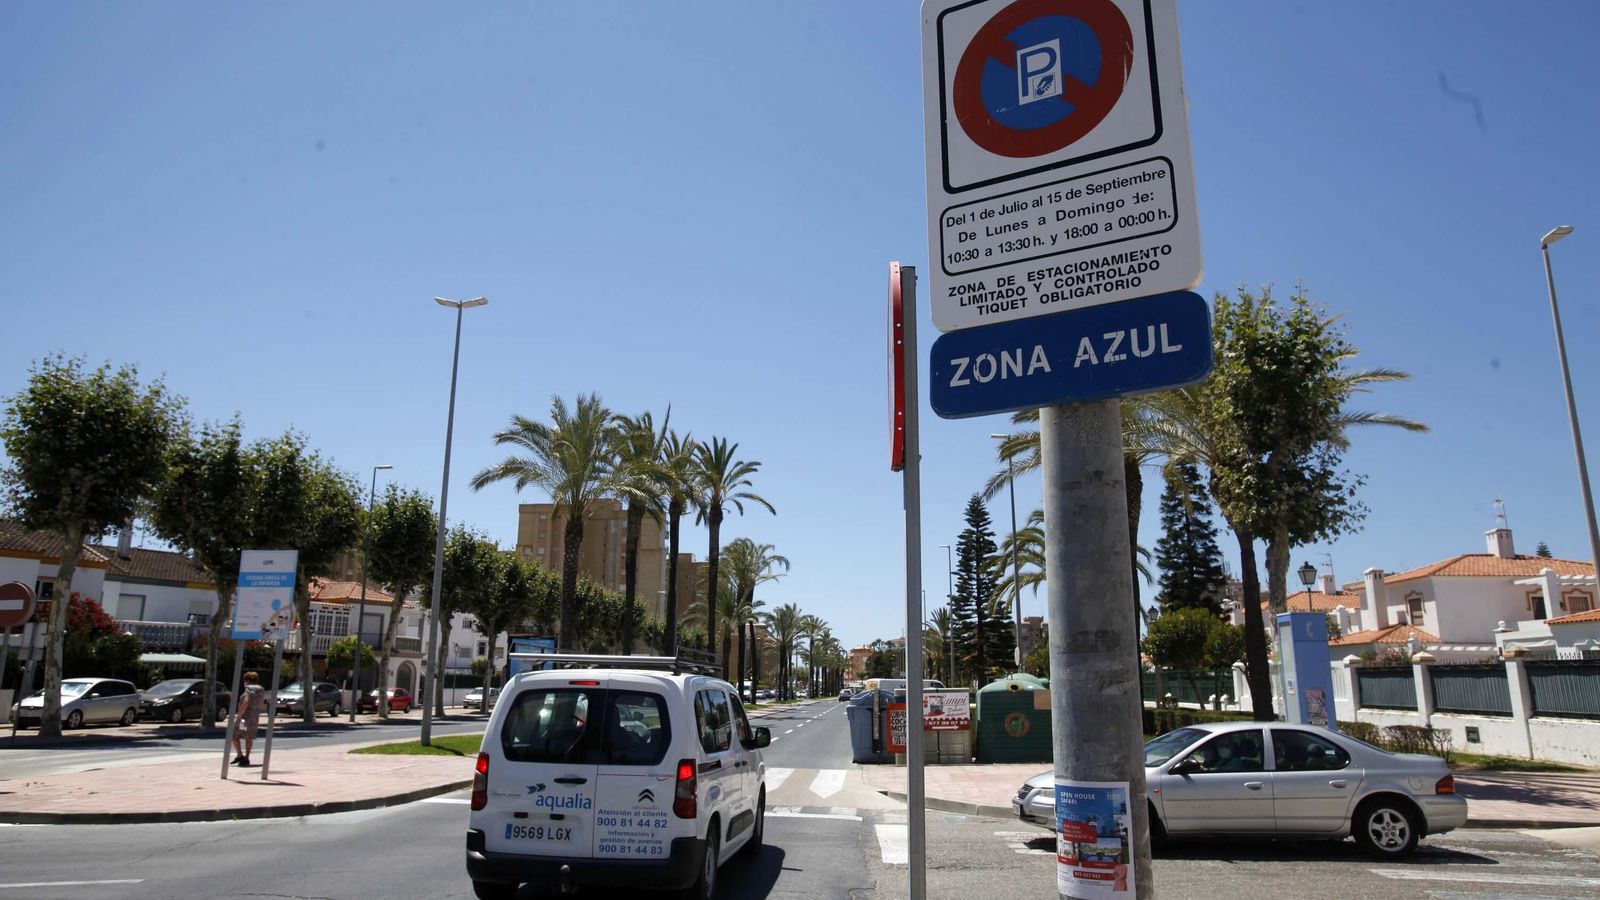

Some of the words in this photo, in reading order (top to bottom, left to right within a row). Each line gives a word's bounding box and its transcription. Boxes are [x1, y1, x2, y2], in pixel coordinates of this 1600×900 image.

[1020, 46, 1057, 97] P
[946, 213, 966, 228] Del
[969, 211, 975, 222] 1
[979, 208, 995, 220] de
[998, 201, 1028, 216] Julio
[1032, 195, 1043, 208] al
[1047, 191, 1062, 204] 15
[1065, 188, 1082, 200] de
[1085, 169, 1166, 195] Septiembre
[947, 248, 980, 265] 10:30
[984, 247, 993, 256] a
[998, 237, 1031, 254] 13:30
[1033, 235, 1045, 247] h.
[1050, 233, 1058, 246] y
[1064, 222, 1099, 240] 18:00
[1104, 222, 1113, 232] a
[1118, 210, 1155, 229] 00:00
[1158, 208, 1171, 220] h.
[958, 231, 977, 243] De
[985, 220, 1029, 237] Lunes
[1038, 216, 1046, 225] a
[1056, 198, 1125, 222] Domingo
[948, 281, 986, 297] ZONA
[996, 275, 1016, 288] DE
[1027, 243, 1172, 283] ESTACIONAMIENTO
[959, 285, 1026, 307] LIMITADO
[1033, 282, 1043, 293] Y
[1053, 259, 1160, 289] CONTROLADO
[976, 297, 1028, 316] TIQUET
[1039, 276, 1142, 305] OBLIGATORIO
[950, 344, 1052, 388] ZONA
[1073, 322, 1183, 369] AZUL
[535, 793, 592, 811] aqualia
[597, 808, 632, 817] Atención
[1060, 791, 1073, 799] OPEN
[513, 825, 544, 839] 9569
[547, 827, 572, 841] LGX
[597, 817, 617, 827] 900
[620, 818, 633, 827] 81
[636, 819, 650, 828] 44
[654, 820, 668, 829] 82
[598, 844, 617, 853] 900
[620, 845, 632, 854] 81
[634, 846, 647, 854] 44
[650, 846, 663, 855] 83
